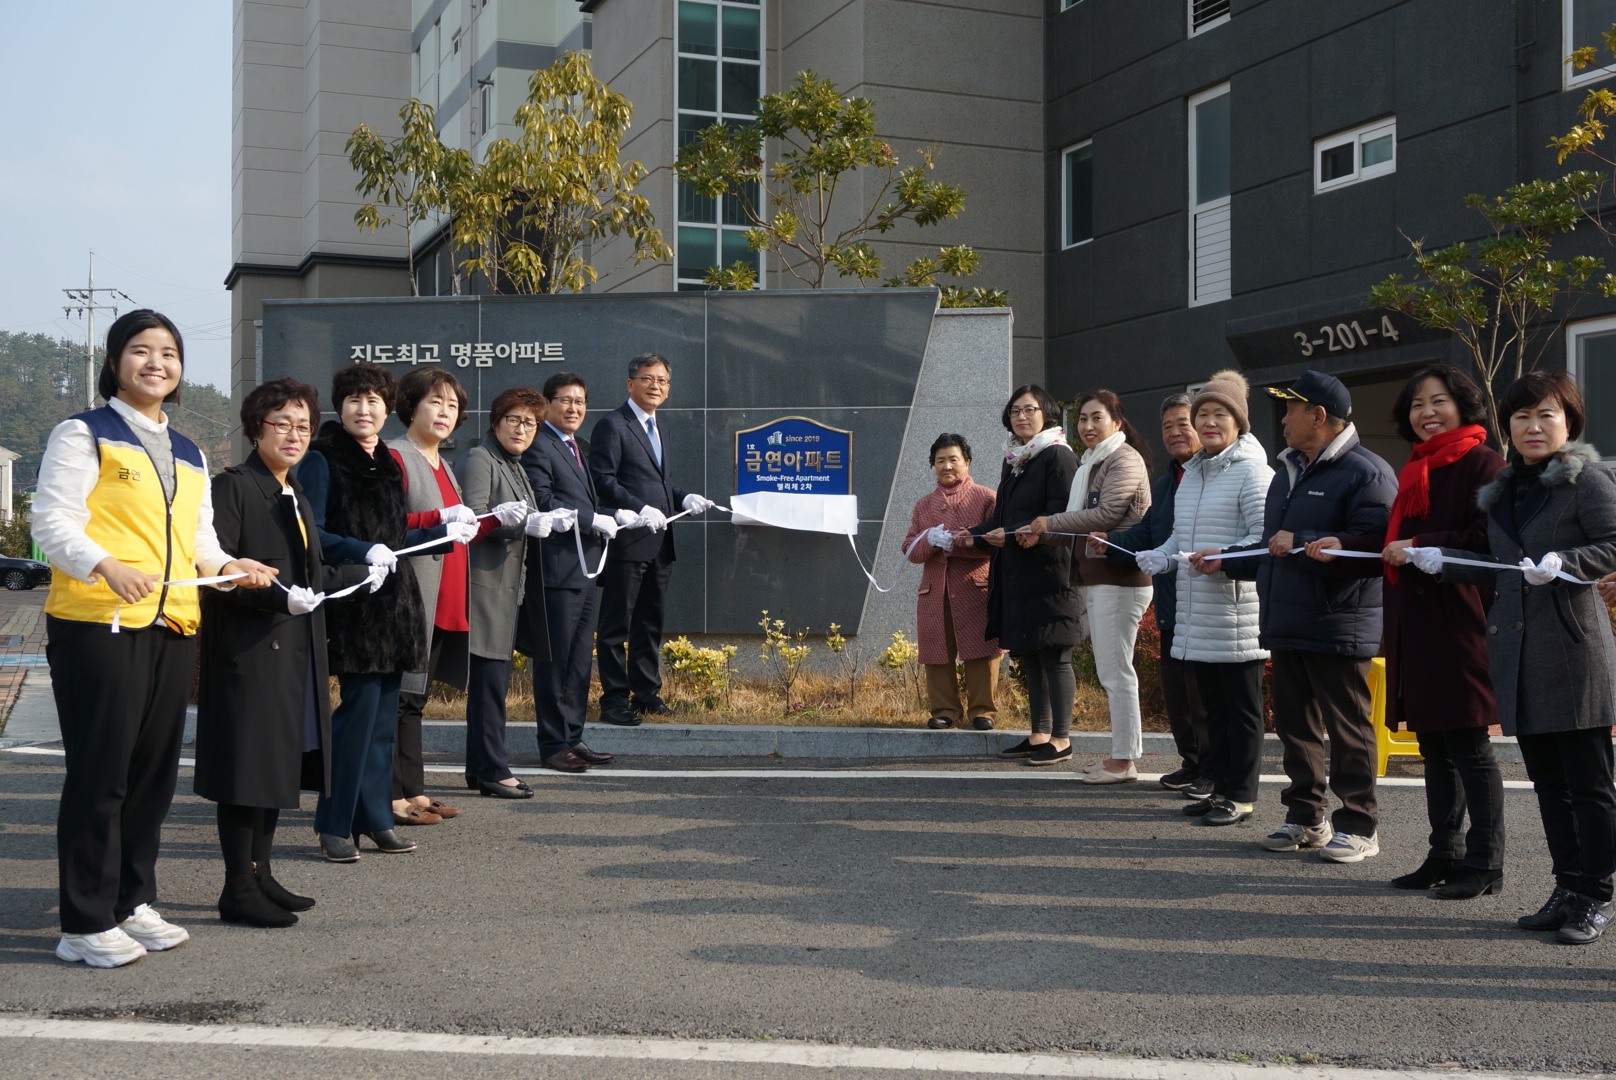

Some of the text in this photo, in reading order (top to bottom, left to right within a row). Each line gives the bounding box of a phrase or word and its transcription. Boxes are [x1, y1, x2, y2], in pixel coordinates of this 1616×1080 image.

[1293, 315, 1400, 357] 3-201-4
[350, 341, 565, 368] 진도최고 명품아파트
[785, 434, 820, 443] since 2019
[744, 450, 843, 473] 금연아파트
[118, 467, 141, 482] 금연
[755, 474, 830, 483] Smoke-Free Apartment
[800, 483, 813, 491] 2차
